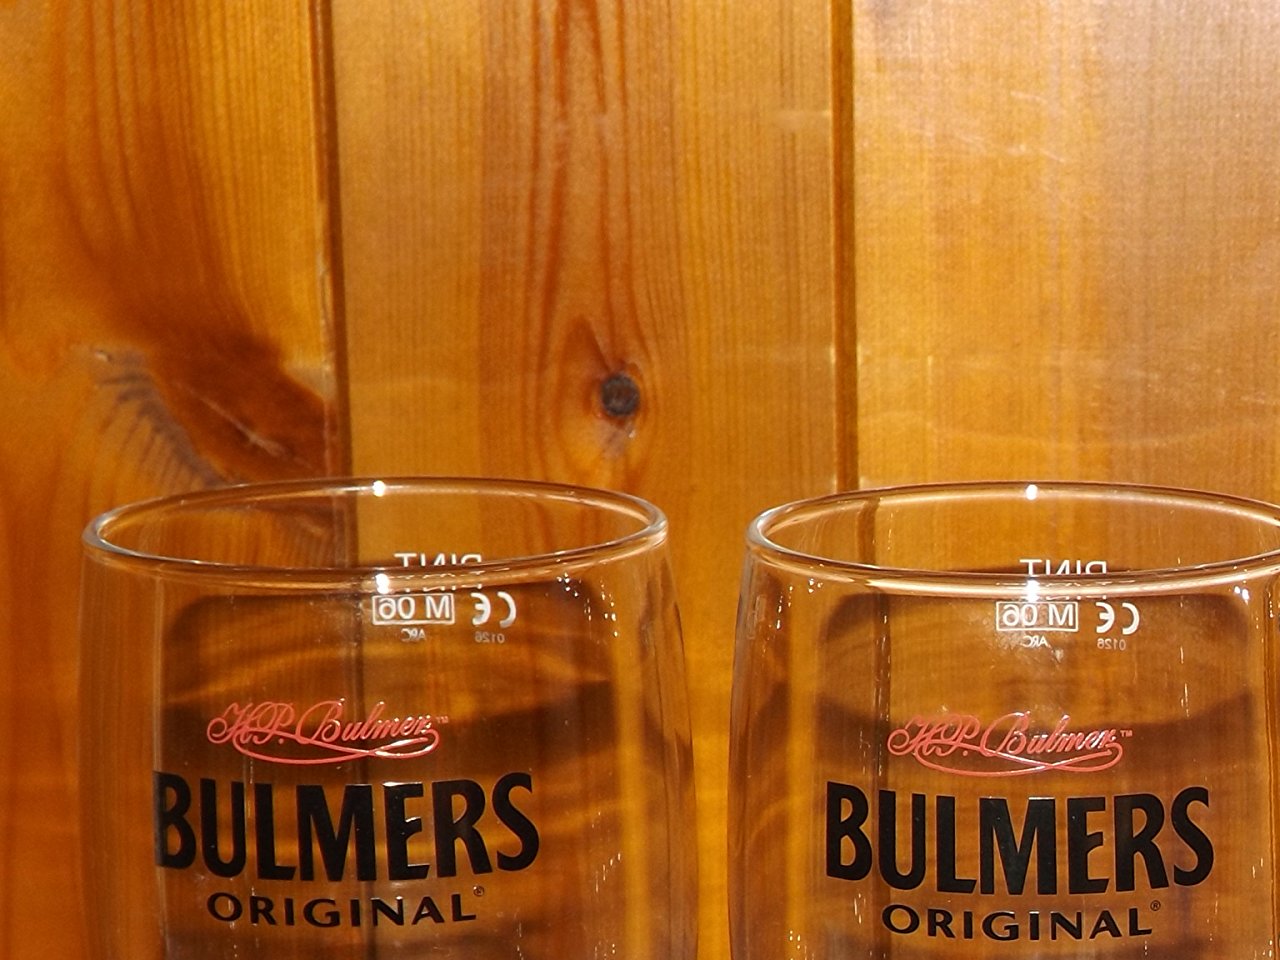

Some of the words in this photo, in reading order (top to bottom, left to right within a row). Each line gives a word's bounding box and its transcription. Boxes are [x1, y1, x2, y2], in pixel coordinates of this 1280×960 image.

[153, 771, 540, 882] BULMERS
[826, 780, 1214, 896] BULMERS
[206, 891, 477, 928] ORIGINAL
[881, 904, 1153, 941] ORIGINAL
